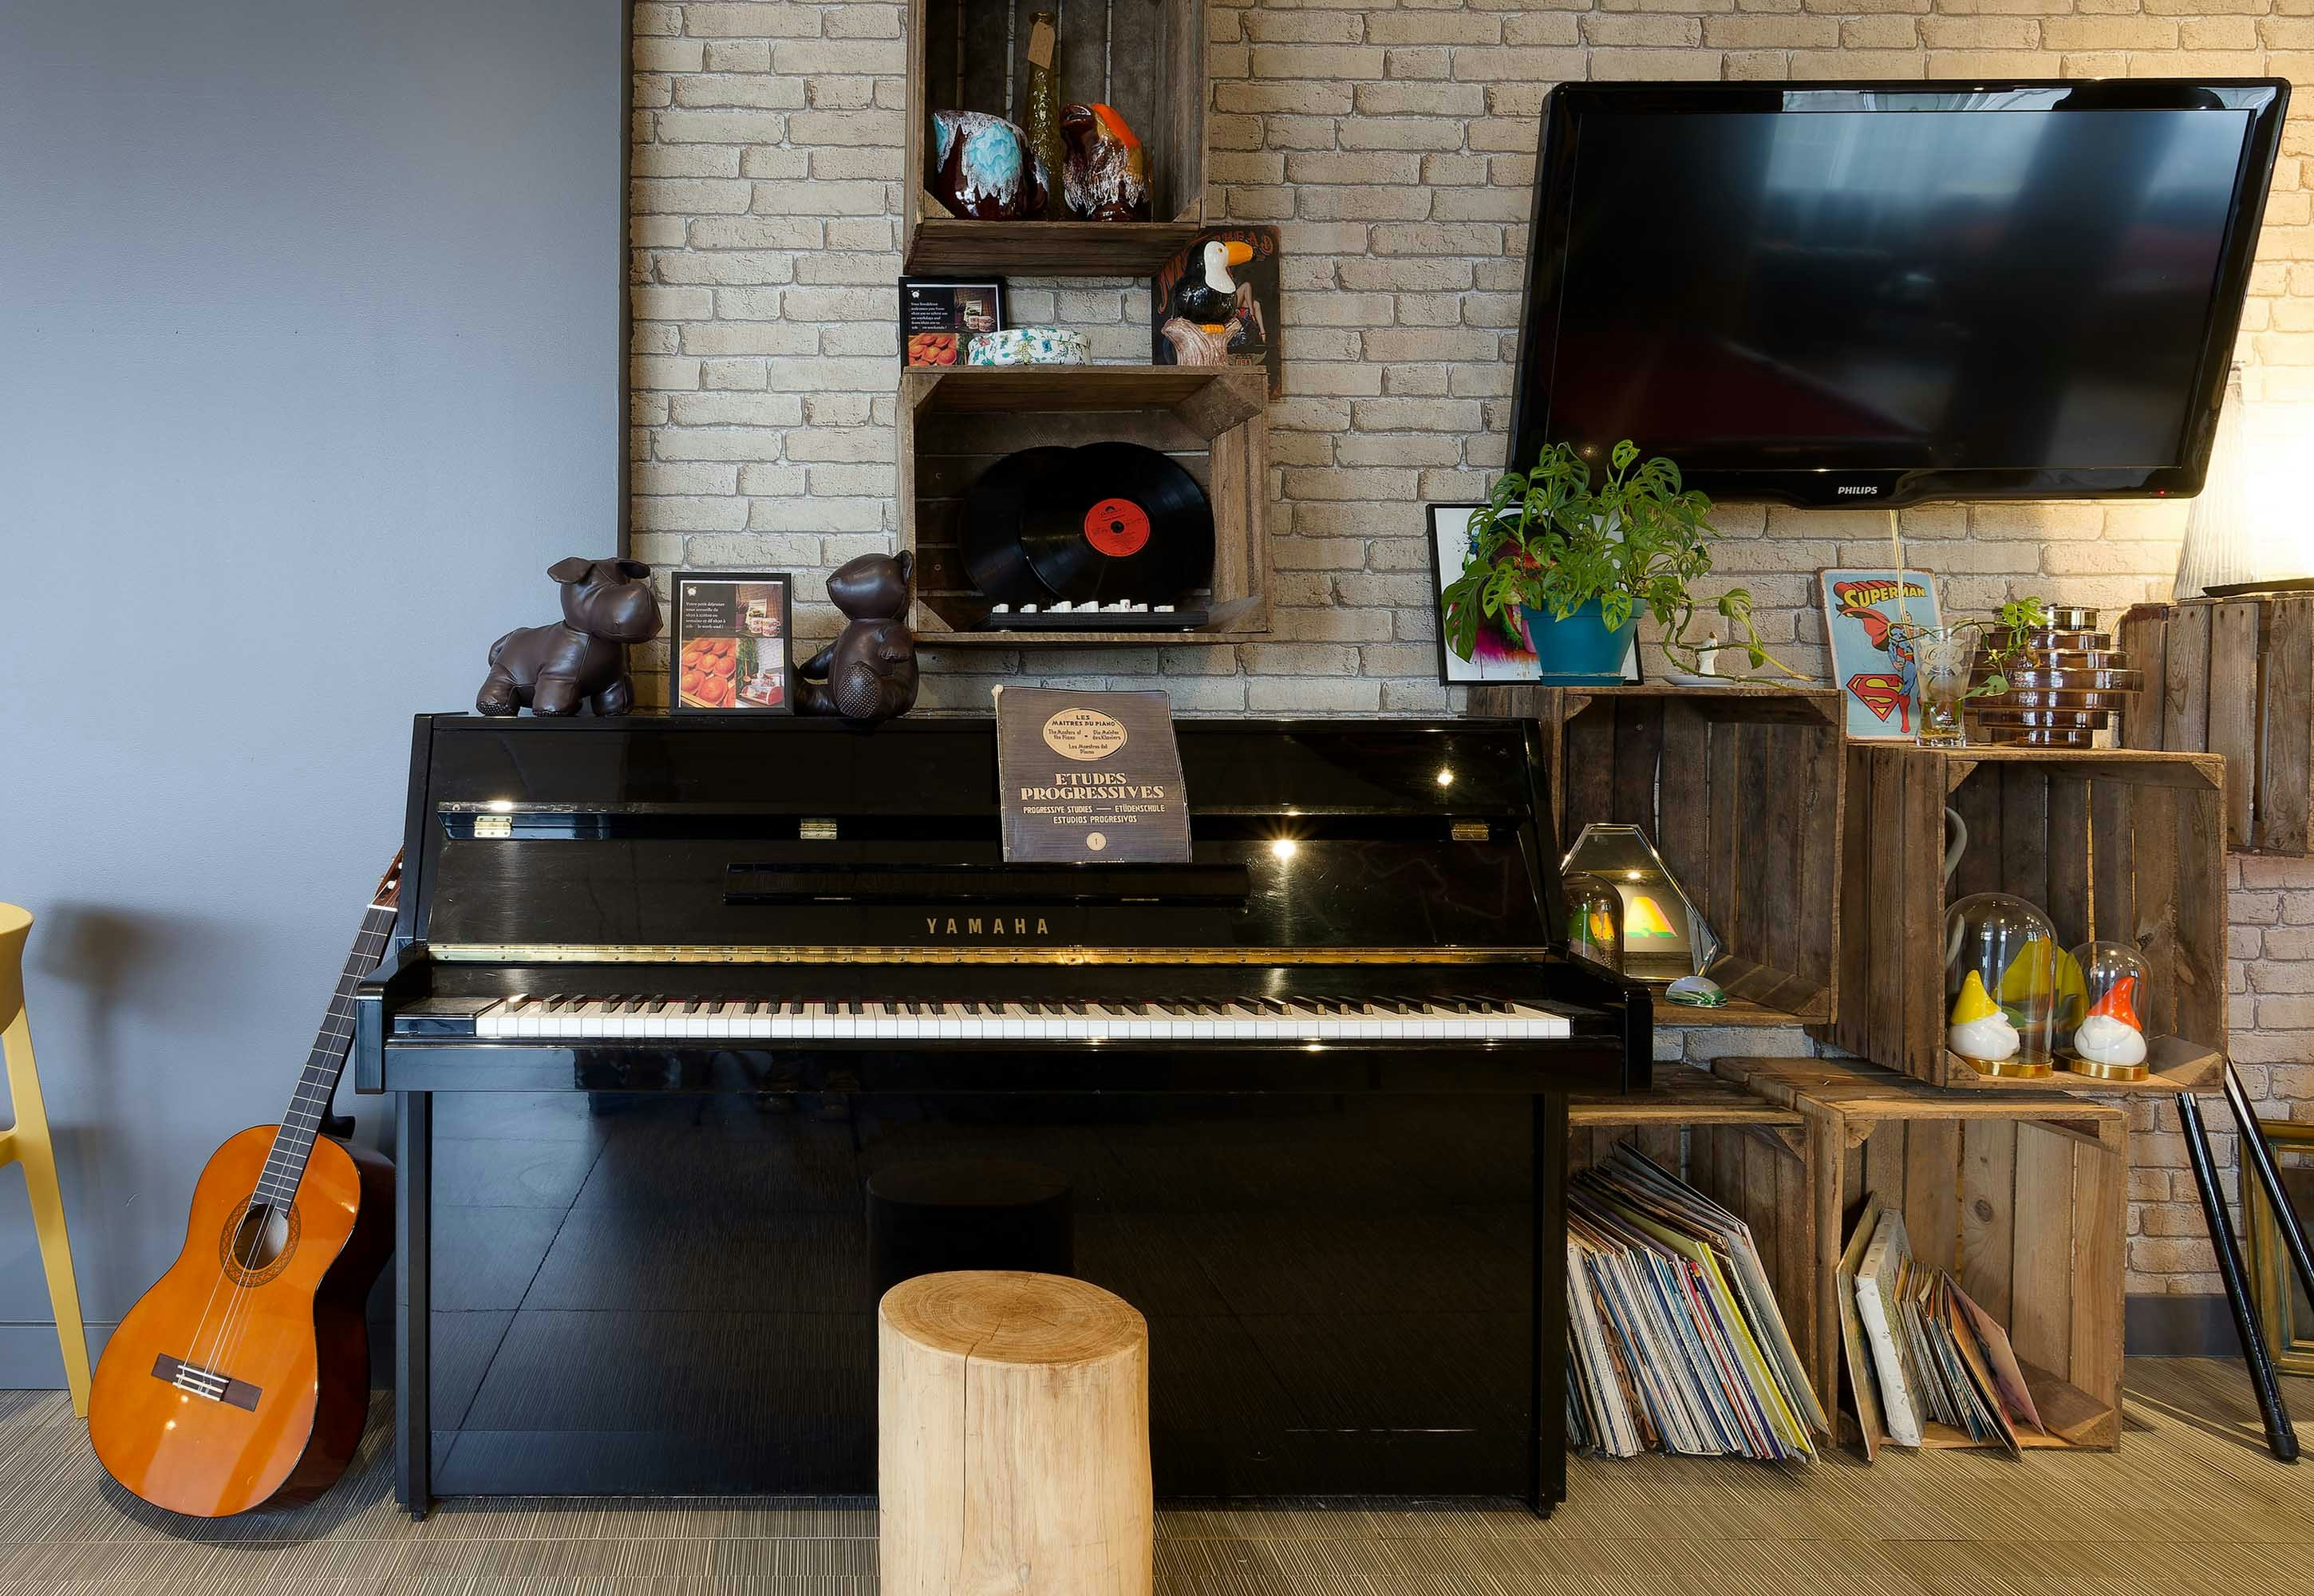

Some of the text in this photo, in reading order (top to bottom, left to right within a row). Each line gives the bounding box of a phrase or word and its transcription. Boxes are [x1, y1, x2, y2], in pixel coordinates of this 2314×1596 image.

[1838, 486, 1878, 495] PHILIPS
[1840, 584, 1927, 608] SUPERMAN
[1055, 772, 1127, 786] ETUDES
[1021, 785, 1166, 801] PROGRESSIVES
[1023, 805, 1065, 814] PROGRESSIVE
[1115, 804, 1165, 813] ETÜDENSCHULE
[1053, 815, 1137, 824] ESTUDIOS PROGRESIVOS
[926, 918, 1049, 934] YAMAHA
